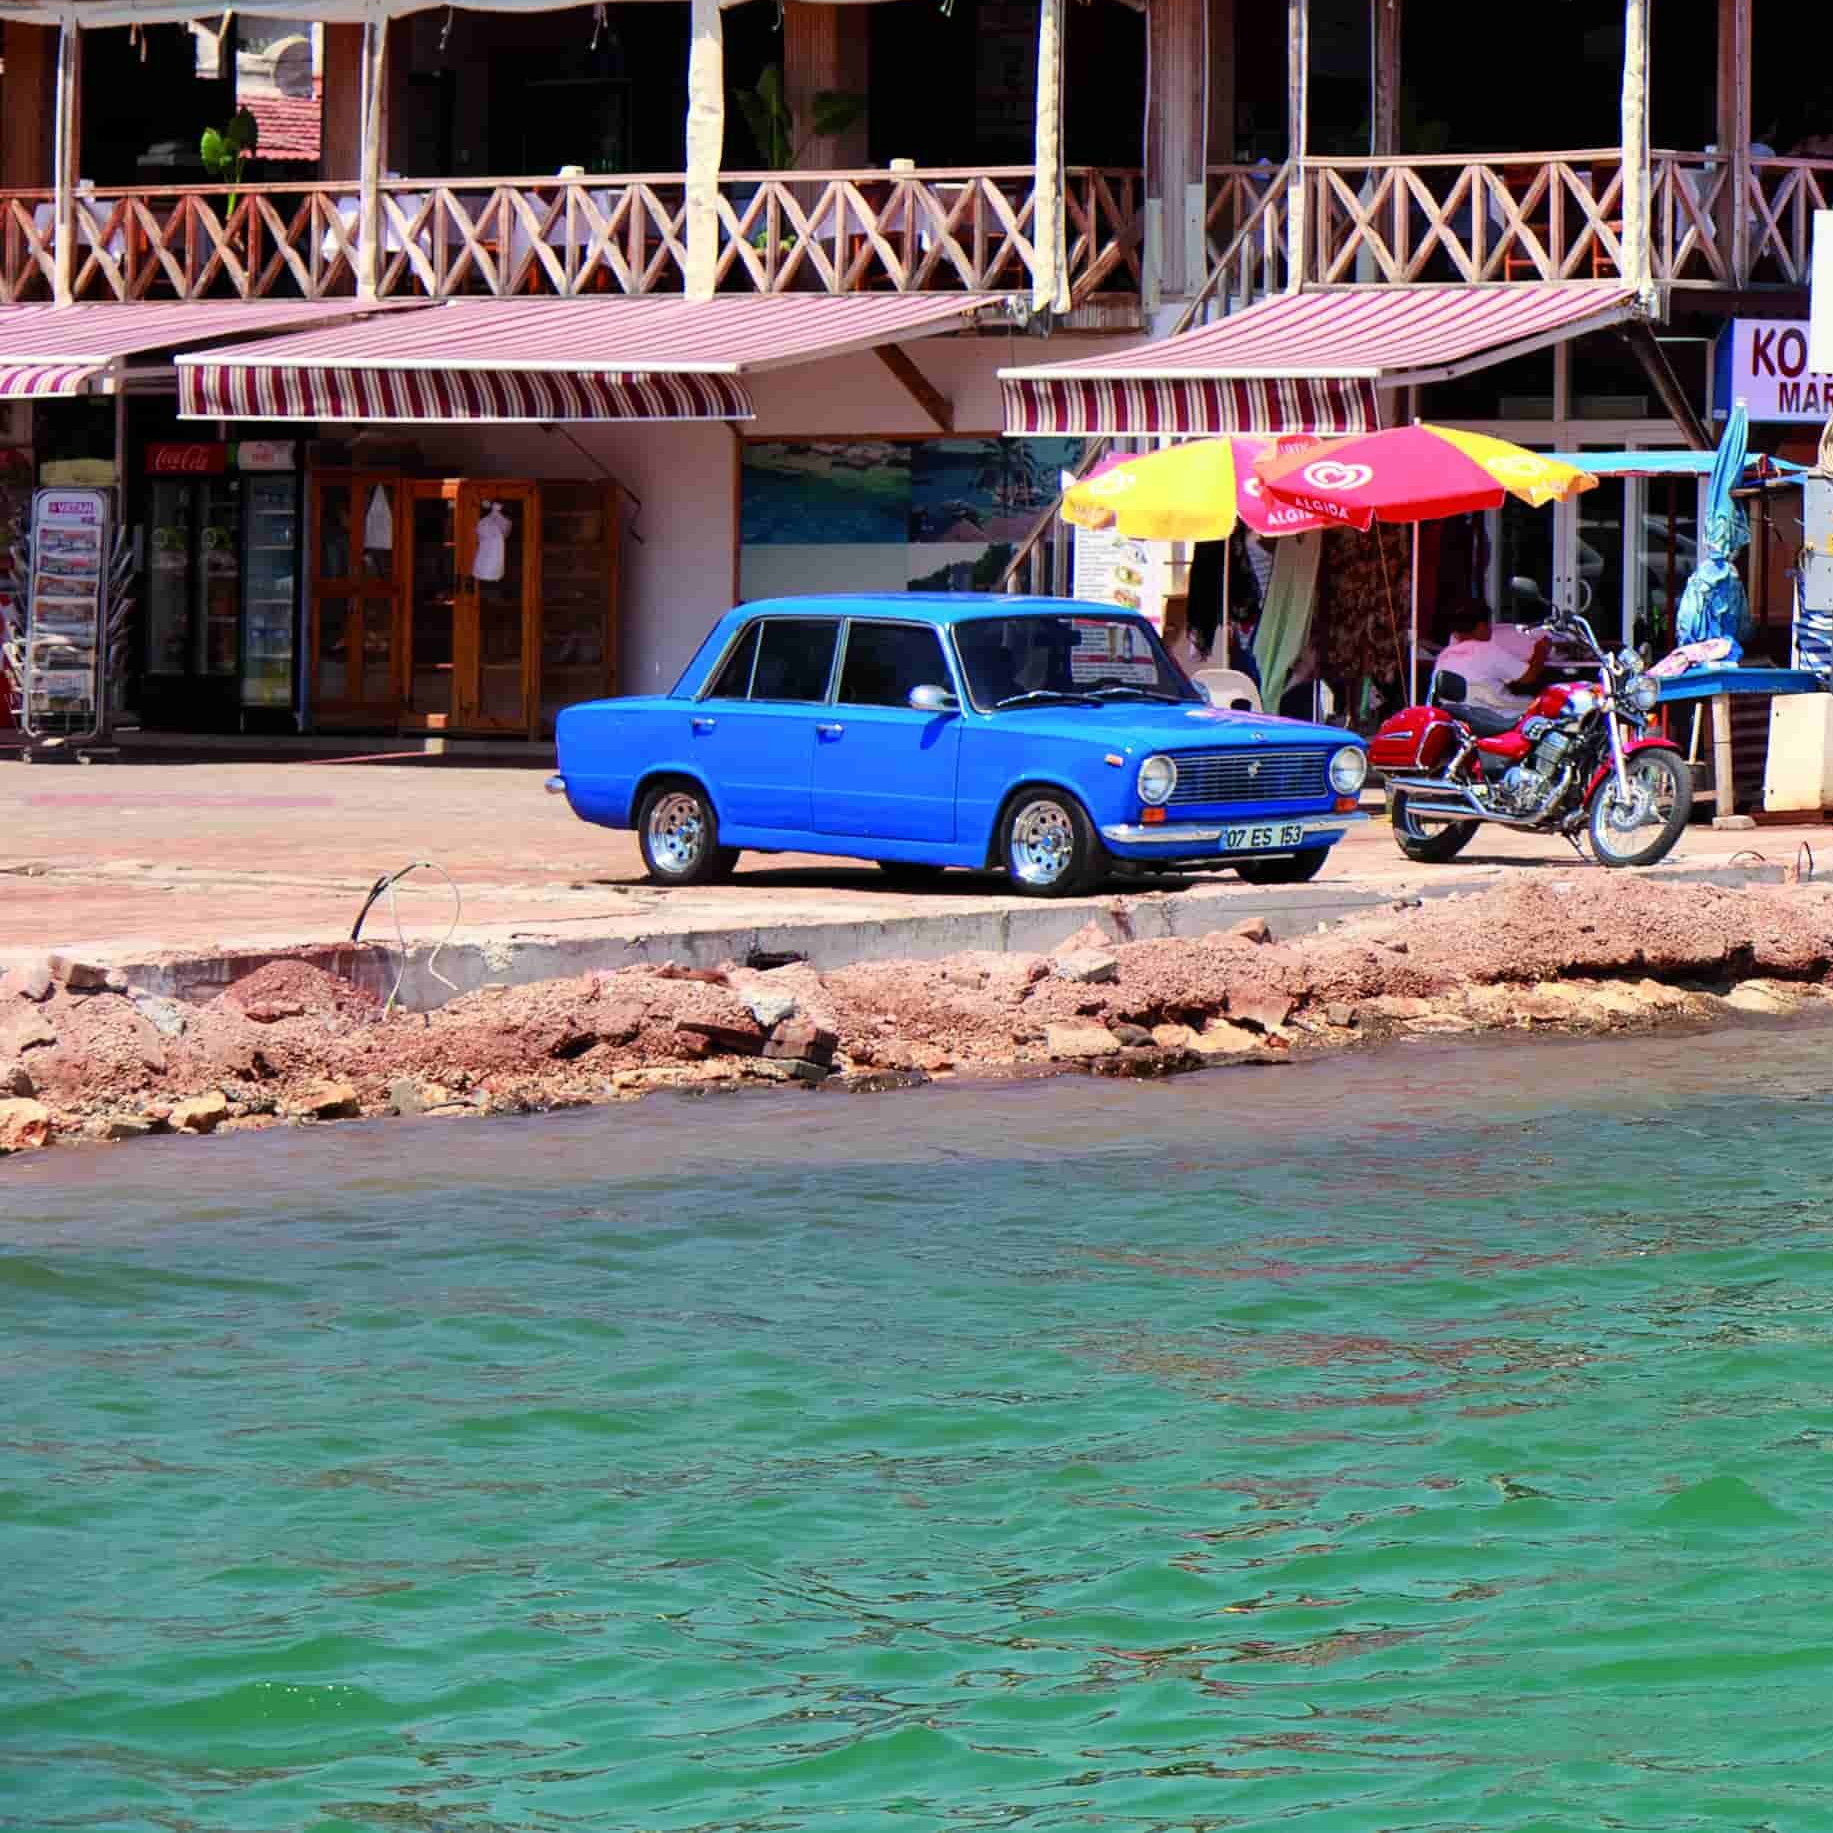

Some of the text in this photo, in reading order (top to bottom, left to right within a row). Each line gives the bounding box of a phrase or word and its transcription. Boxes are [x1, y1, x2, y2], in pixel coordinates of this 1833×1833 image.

[1267, 508, 1314, 526] ALGI
[1295, 496, 1349, 519] ALGIDA
[1227, 826, 1302, 847] 07 ES 153
